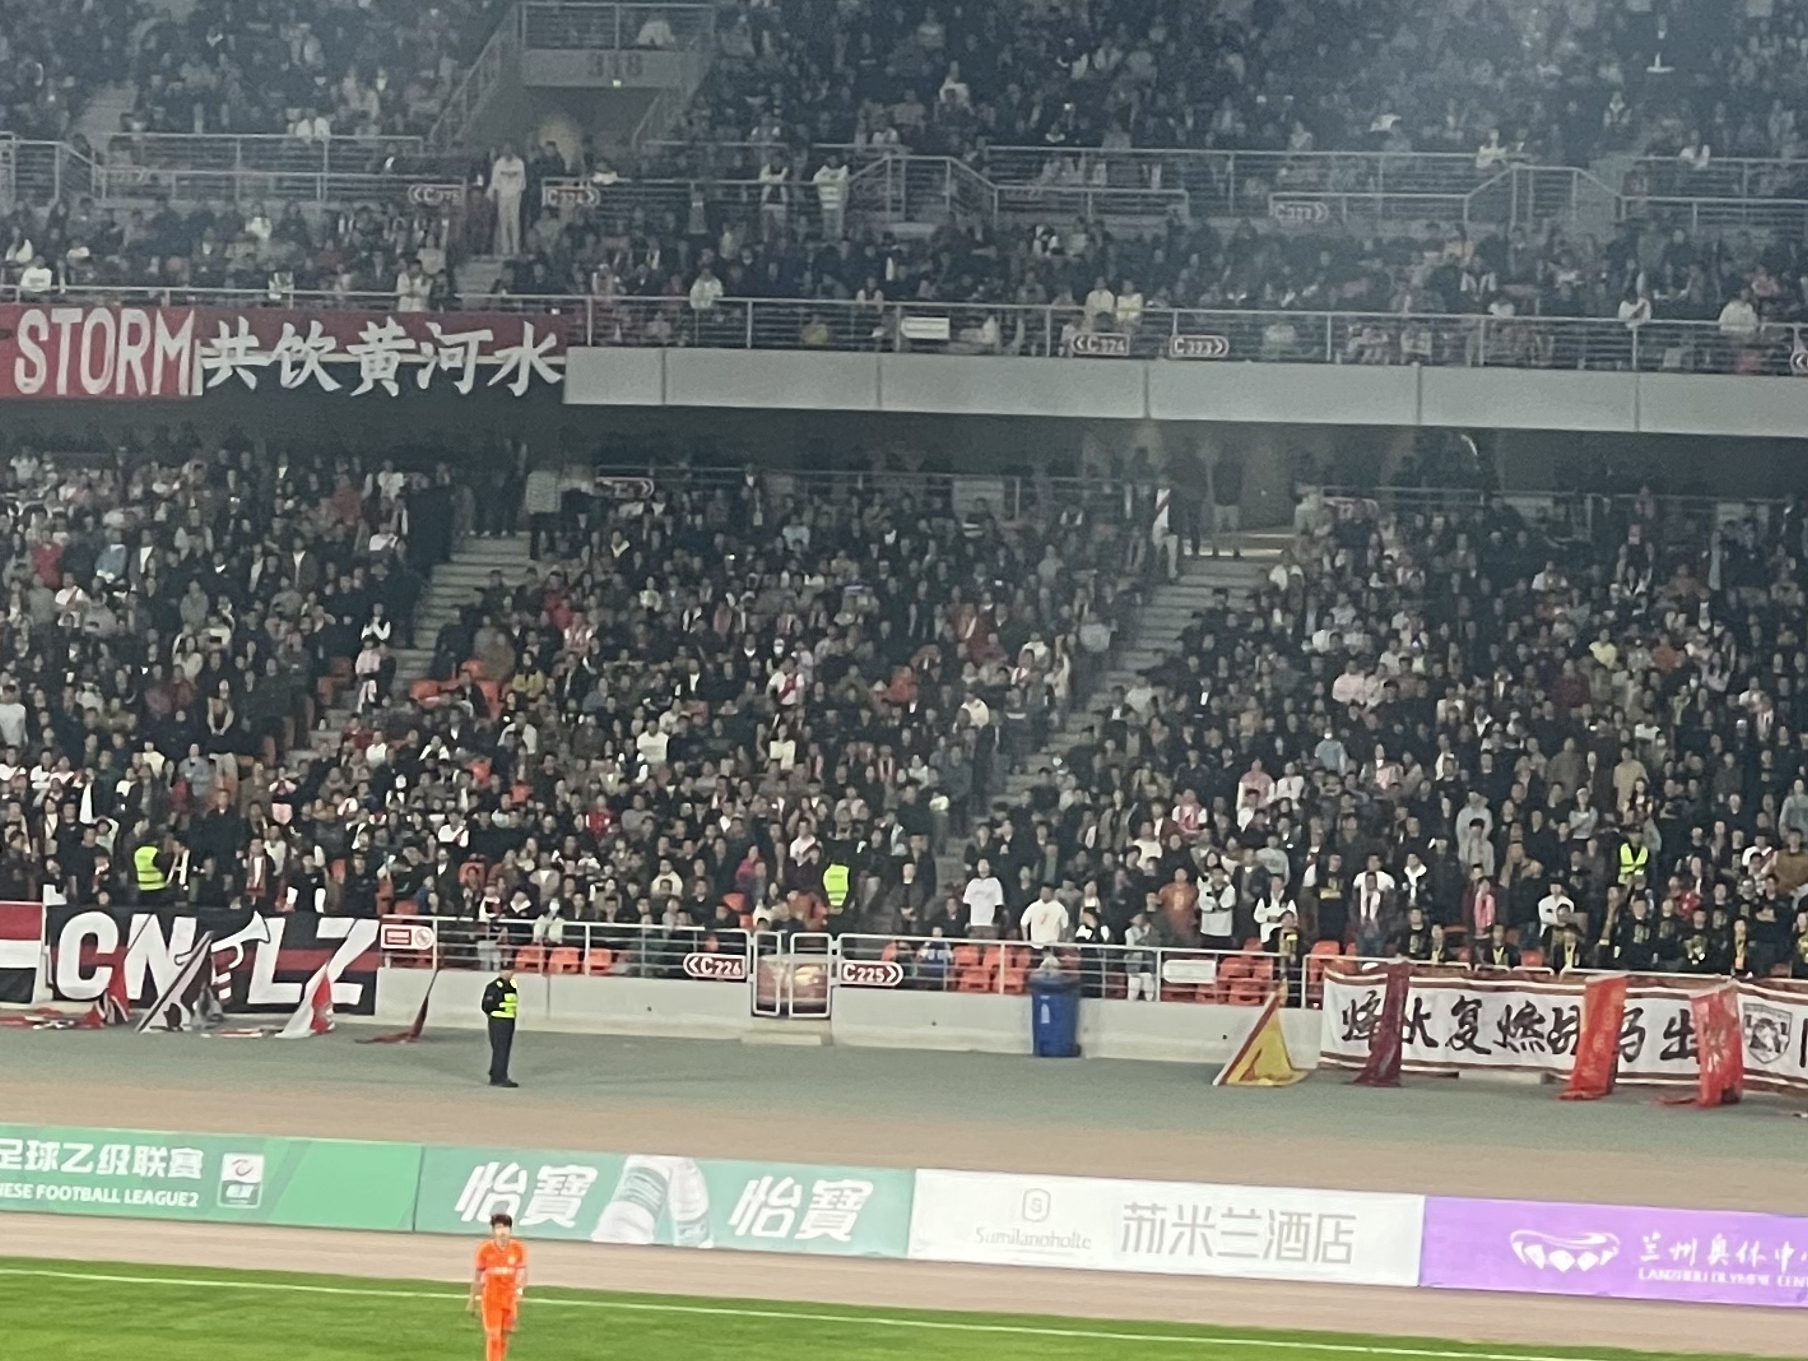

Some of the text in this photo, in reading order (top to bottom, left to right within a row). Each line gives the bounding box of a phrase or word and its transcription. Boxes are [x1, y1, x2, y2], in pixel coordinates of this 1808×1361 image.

[15, 308, 195, 396] STORM
[202, 315, 563, 397] 共饮黄河水
[700, 956, 742, 976] C226
[842, 964, 885, 982] C225
[36, 1184, 120, 1204] FOOTBALL
[124, 1188, 199, 1208] LEAGUE2
[454, 1161, 598, 1229] 怡寶
[728, 1175, 874, 1242] 怡寶
[1120, 1202, 1357, 1265] 苏米兰酒店
